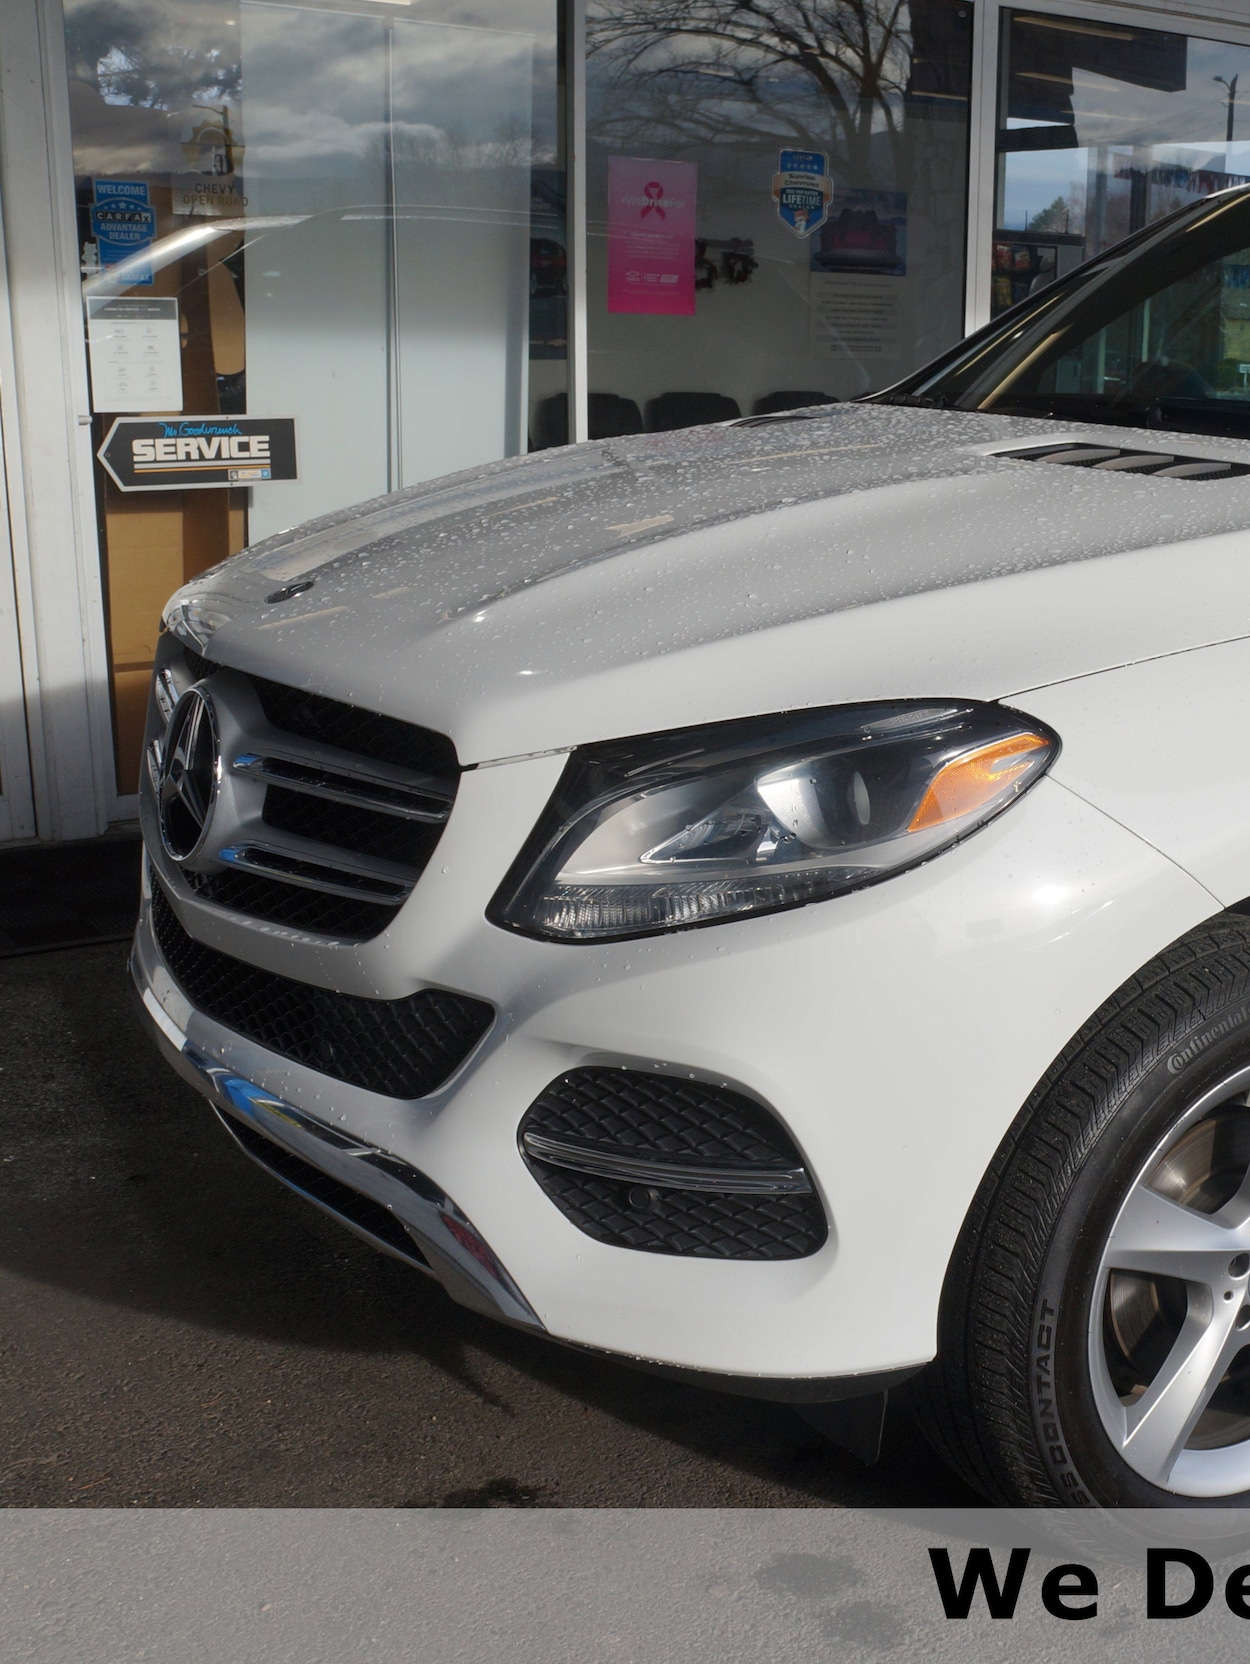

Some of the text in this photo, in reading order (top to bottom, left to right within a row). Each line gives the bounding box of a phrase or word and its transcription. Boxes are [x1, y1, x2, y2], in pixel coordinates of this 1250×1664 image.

[97, 184, 146, 196] WELCOME
[194, 183, 235, 195] CHEVY
[784, 180, 819, 188] Chevrolet
[183, 194, 249, 207] OPEN ROAD
[782, 194, 821, 206] LIFETIME
[96, 211, 151, 223] CARFAX
[100, 223, 148, 232] ADVANTAGE
[109, 232, 141, 240] DEALER
[131, 435, 271, 462] SERVICE
[1166, 1007, 1249, 1075] Continental
[1037, 1299, 1067, 1466] CONTACT
